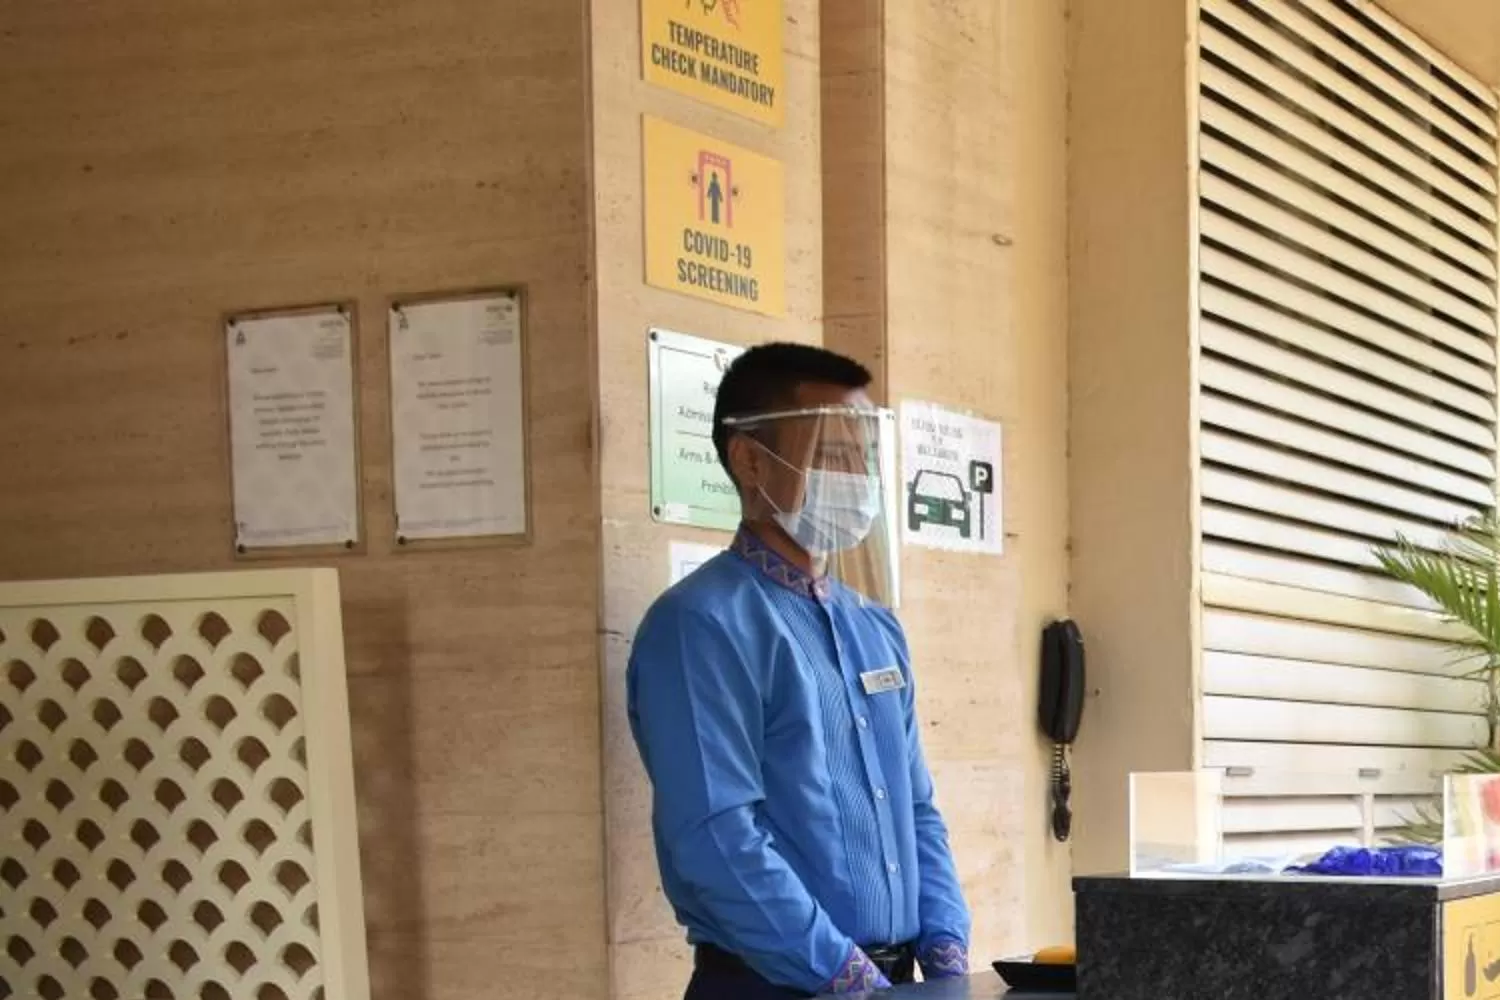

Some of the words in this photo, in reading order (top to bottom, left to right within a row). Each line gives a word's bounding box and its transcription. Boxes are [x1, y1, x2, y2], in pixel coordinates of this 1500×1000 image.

[668, 19, 759, 75] TEMPERATURE
[651, 43, 697, 81] CHECK
[701, 61, 775, 108] MANDATORY
[684, 228, 752, 269] COVID-19
[677, 258, 759, 302] SCREENING
[975, 467, 988, 487] P
